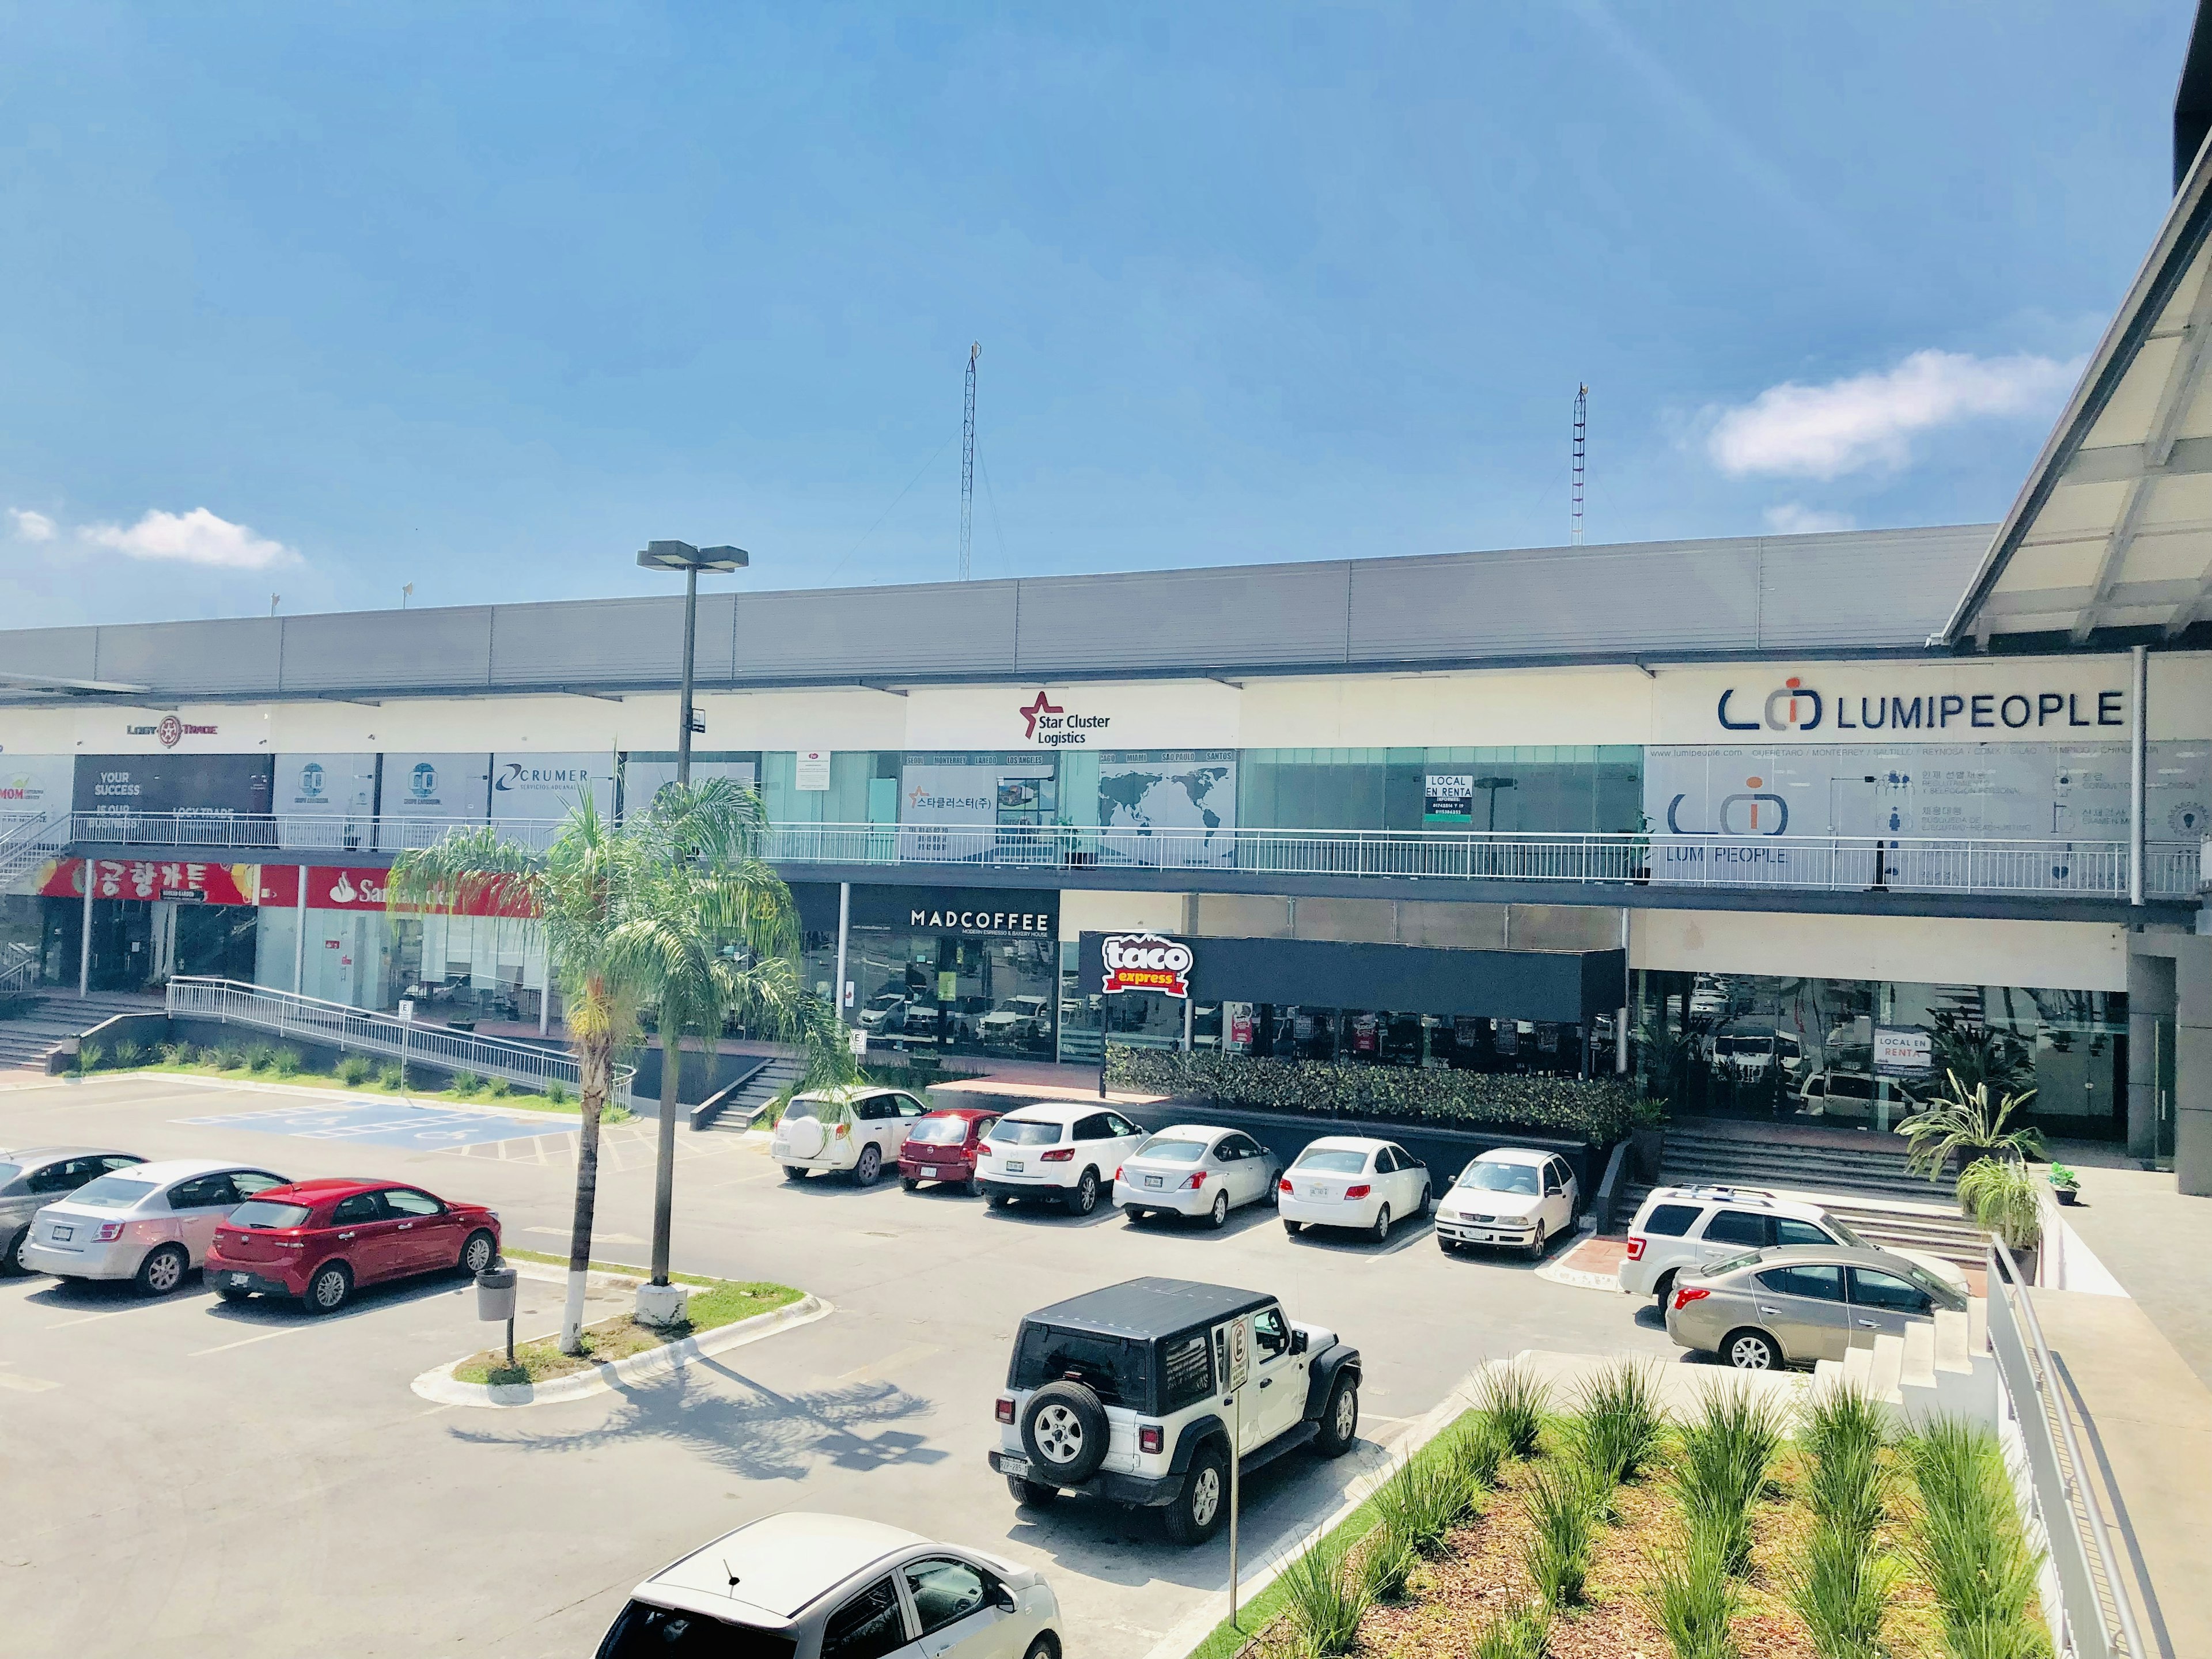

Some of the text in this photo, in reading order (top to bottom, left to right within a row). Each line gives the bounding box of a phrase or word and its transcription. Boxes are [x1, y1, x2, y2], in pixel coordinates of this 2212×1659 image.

[1837, 692, 2123, 729] LUMIPEOPLE
[1039, 714, 1110, 729] Star Cluster
[1038, 731, 1086, 747] Logistics
[1127, 753, 1146, 762] MIAMI
[1176, 753, 1195, 761] PAULO
[1207, 752, 1232, 760] SANTOS
[1650, 749, 1742, 757] www.lumipeople.com
[907, 756, 997, 764] SEOUL MONTERREY LAREDO
[1018, 756, 1042, 764] ANGELES
[100, 772, 129, 783] YOUR
[520, 770, 588, 781] CRUMER
[1432, 777, 1465, 785] LOCAL
[95, 785, 139, 795] SUCCESS
[1427, 787, 1471, 797] EN RENTA
[917, 797, 991, 809] 스타클러스터(주)
[1666, 846, 1788, 863] LUMPEOPLE
[911, 910, 1048, 931] MADCOFFEE
[1107, 941, 1188, 971] taco
[1118, 972, 1173, 985] express
[1880, 1038, 1910, 1046] LOCAL
[1885, 1047, 1920, 1058] RENTA
[1237, 1330, 1243, 1356] E
